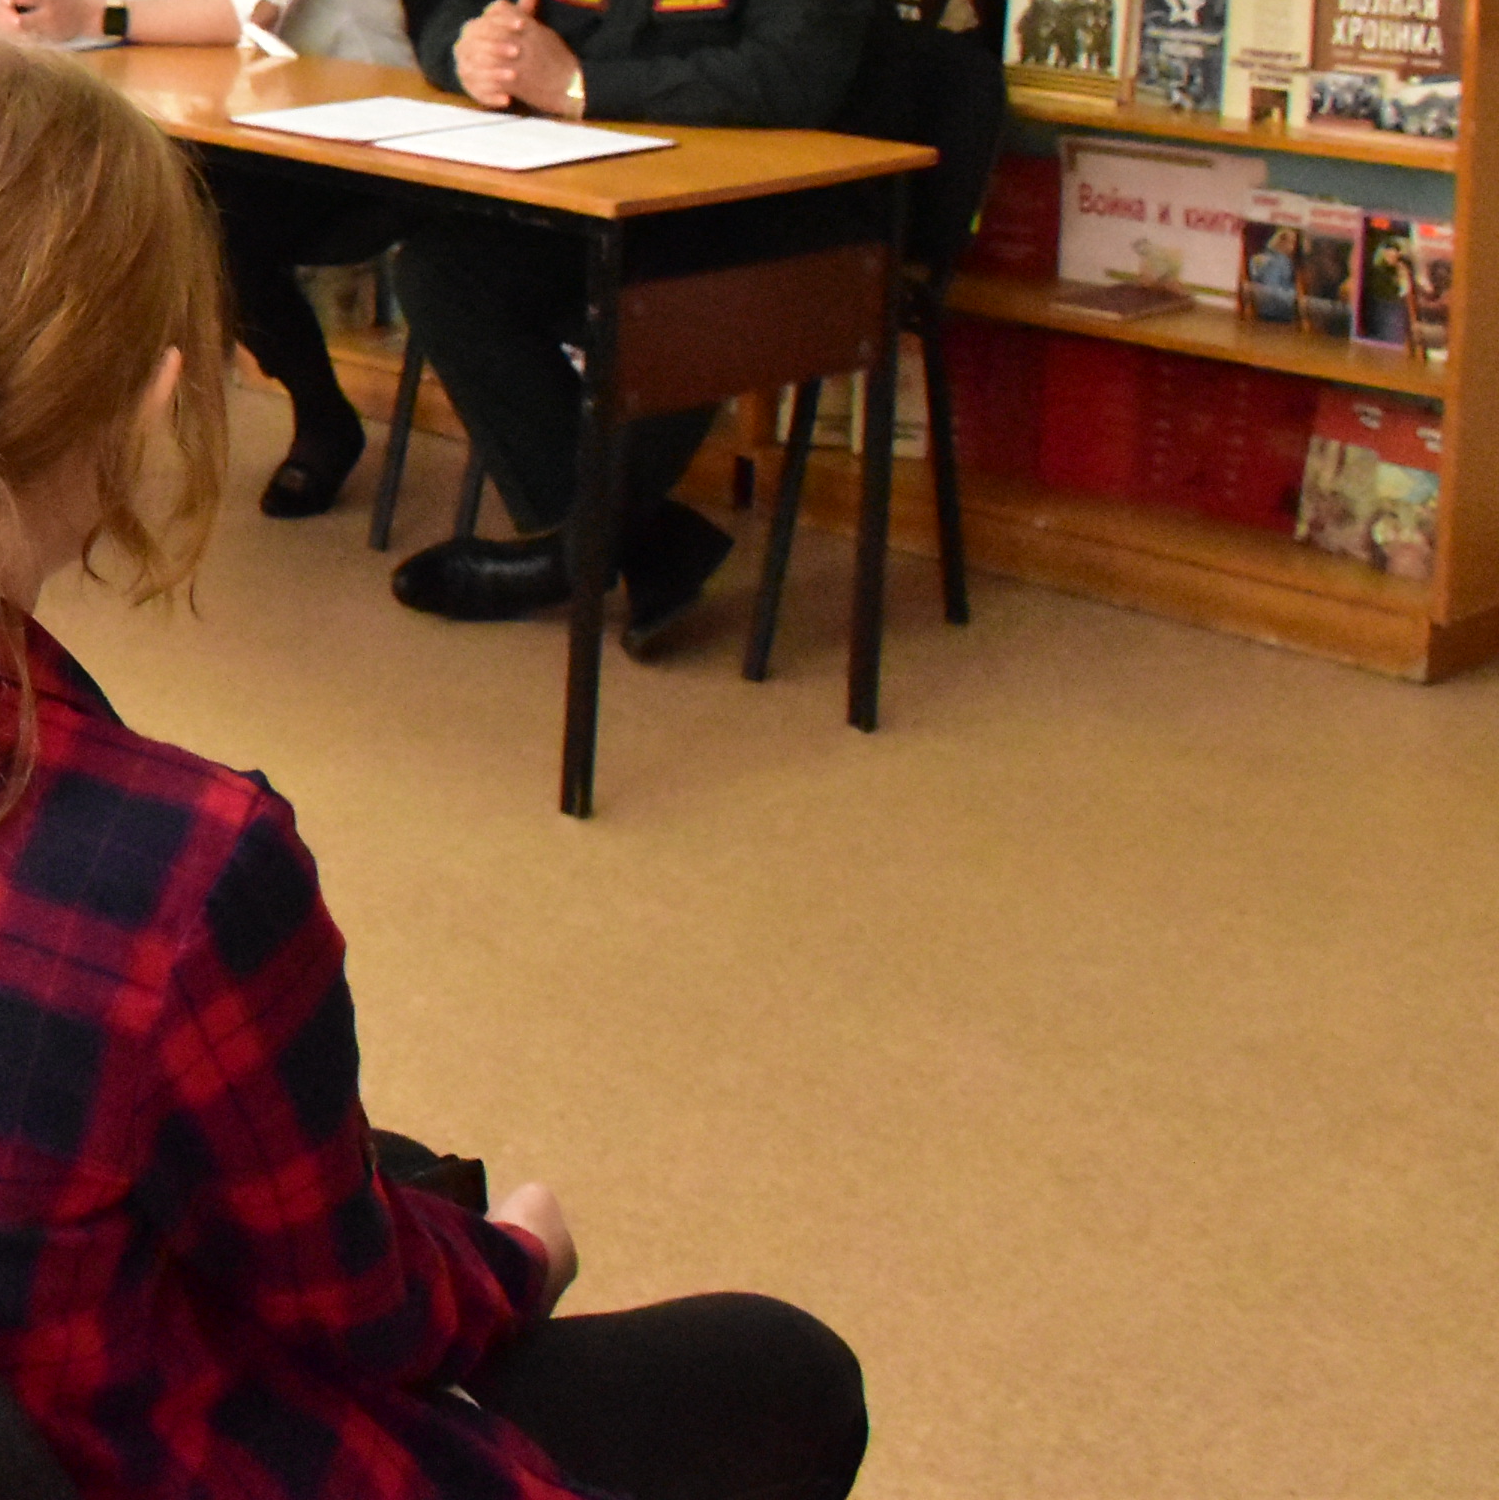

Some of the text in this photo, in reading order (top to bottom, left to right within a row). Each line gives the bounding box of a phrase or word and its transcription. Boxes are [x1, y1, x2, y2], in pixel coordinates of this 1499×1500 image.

[1331, 16, 1443, 55] ХРОНИКА
[1078, 182, 1145, 223] Война
[1157, 204, 1171, 226] и
